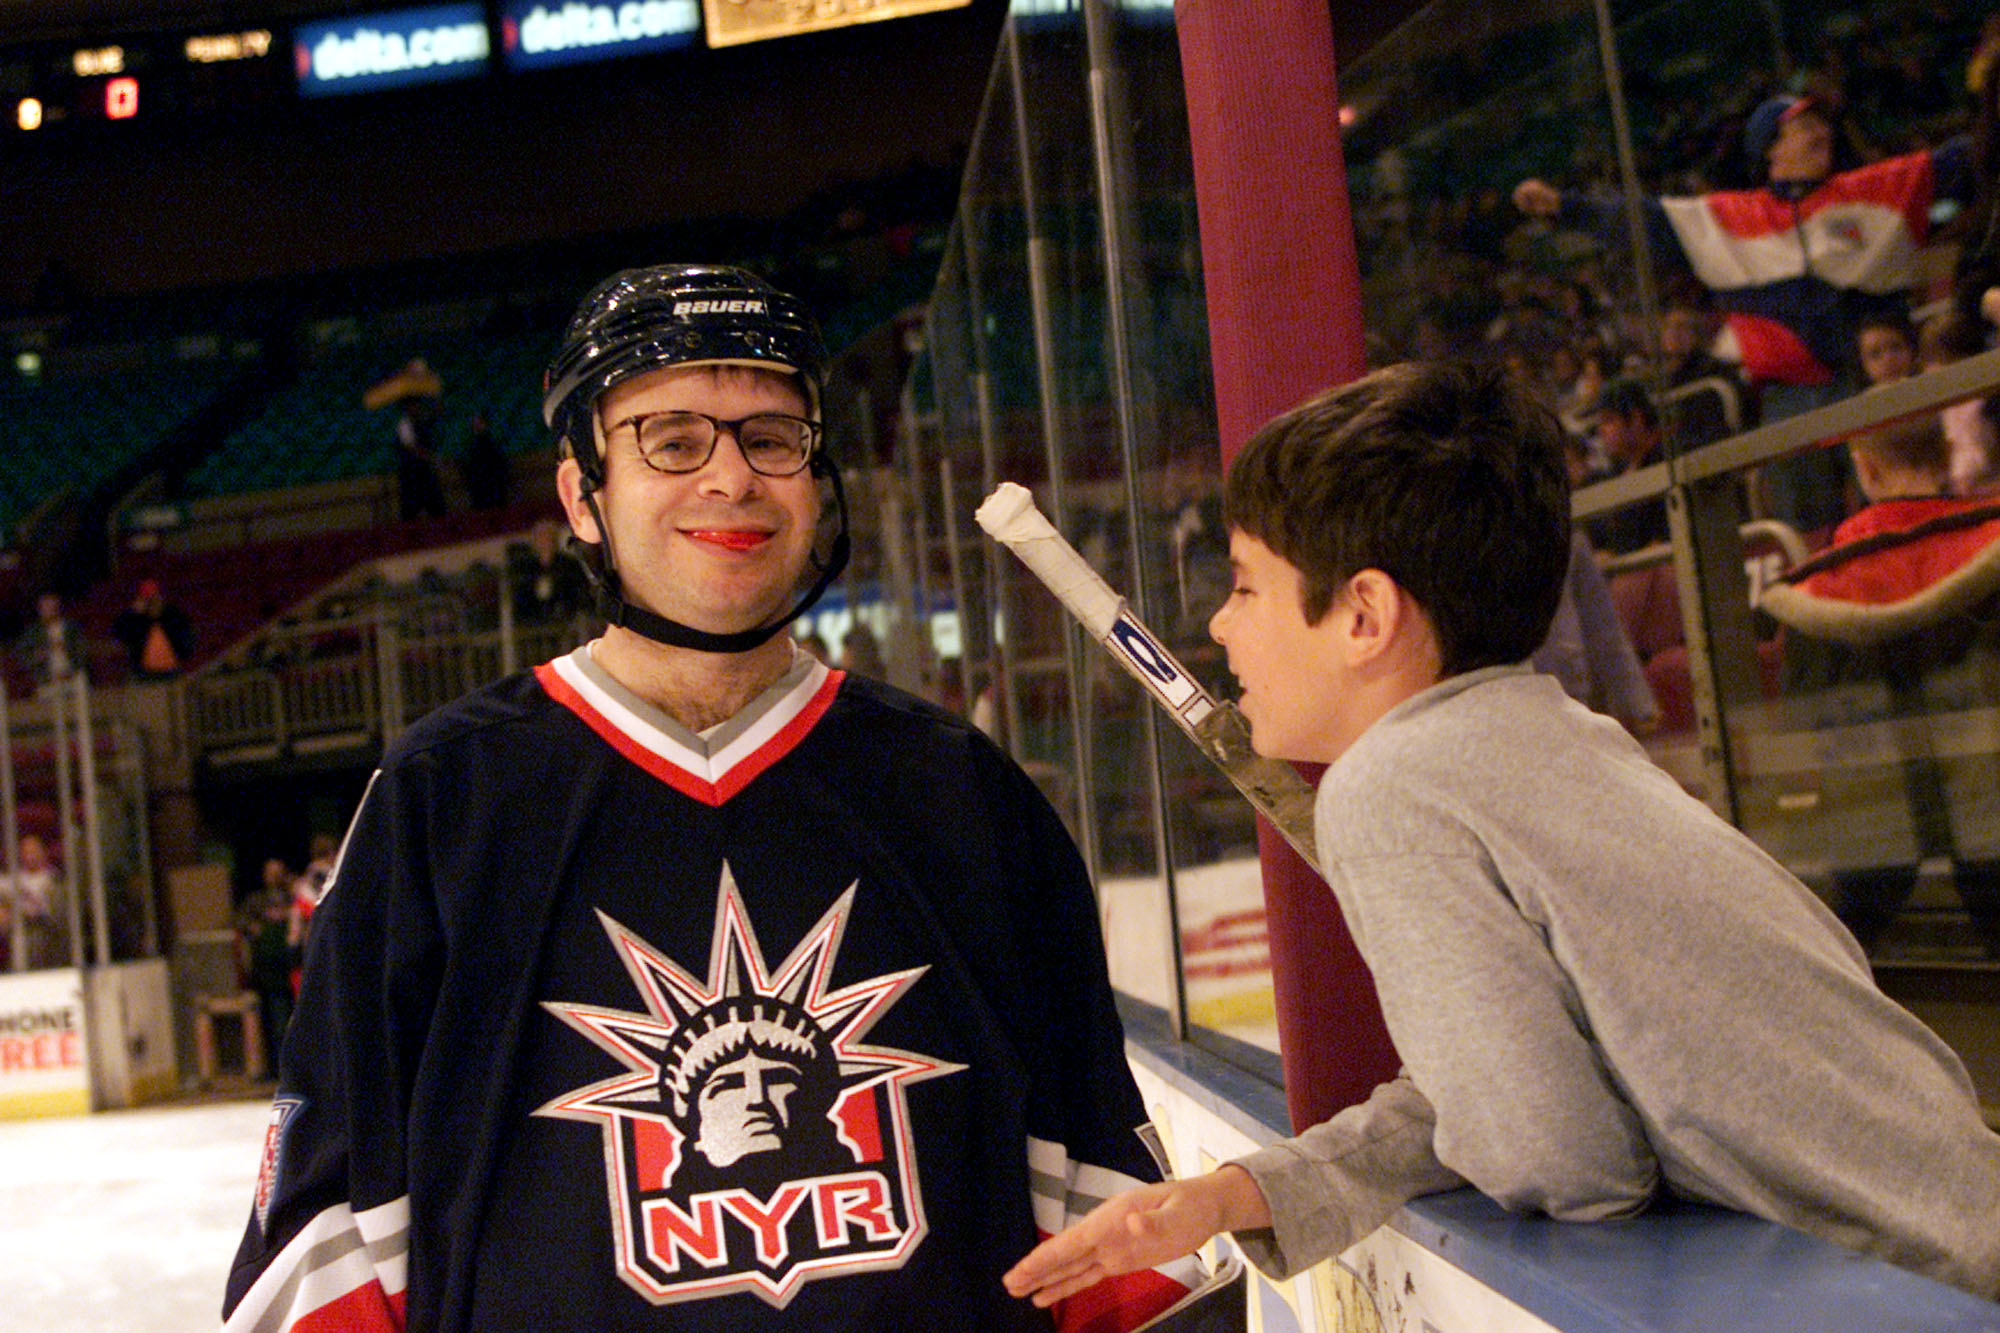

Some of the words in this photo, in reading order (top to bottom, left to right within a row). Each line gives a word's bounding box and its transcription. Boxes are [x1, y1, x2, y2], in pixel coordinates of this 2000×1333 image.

[313, 24, 489, 80] delta.com
[521, 0, 698, 53] delta.com
[106, 77, 138, 119] 0
[673, 300, 764, 315] BAUER
[641, 1171, 902, 1273] NYR
